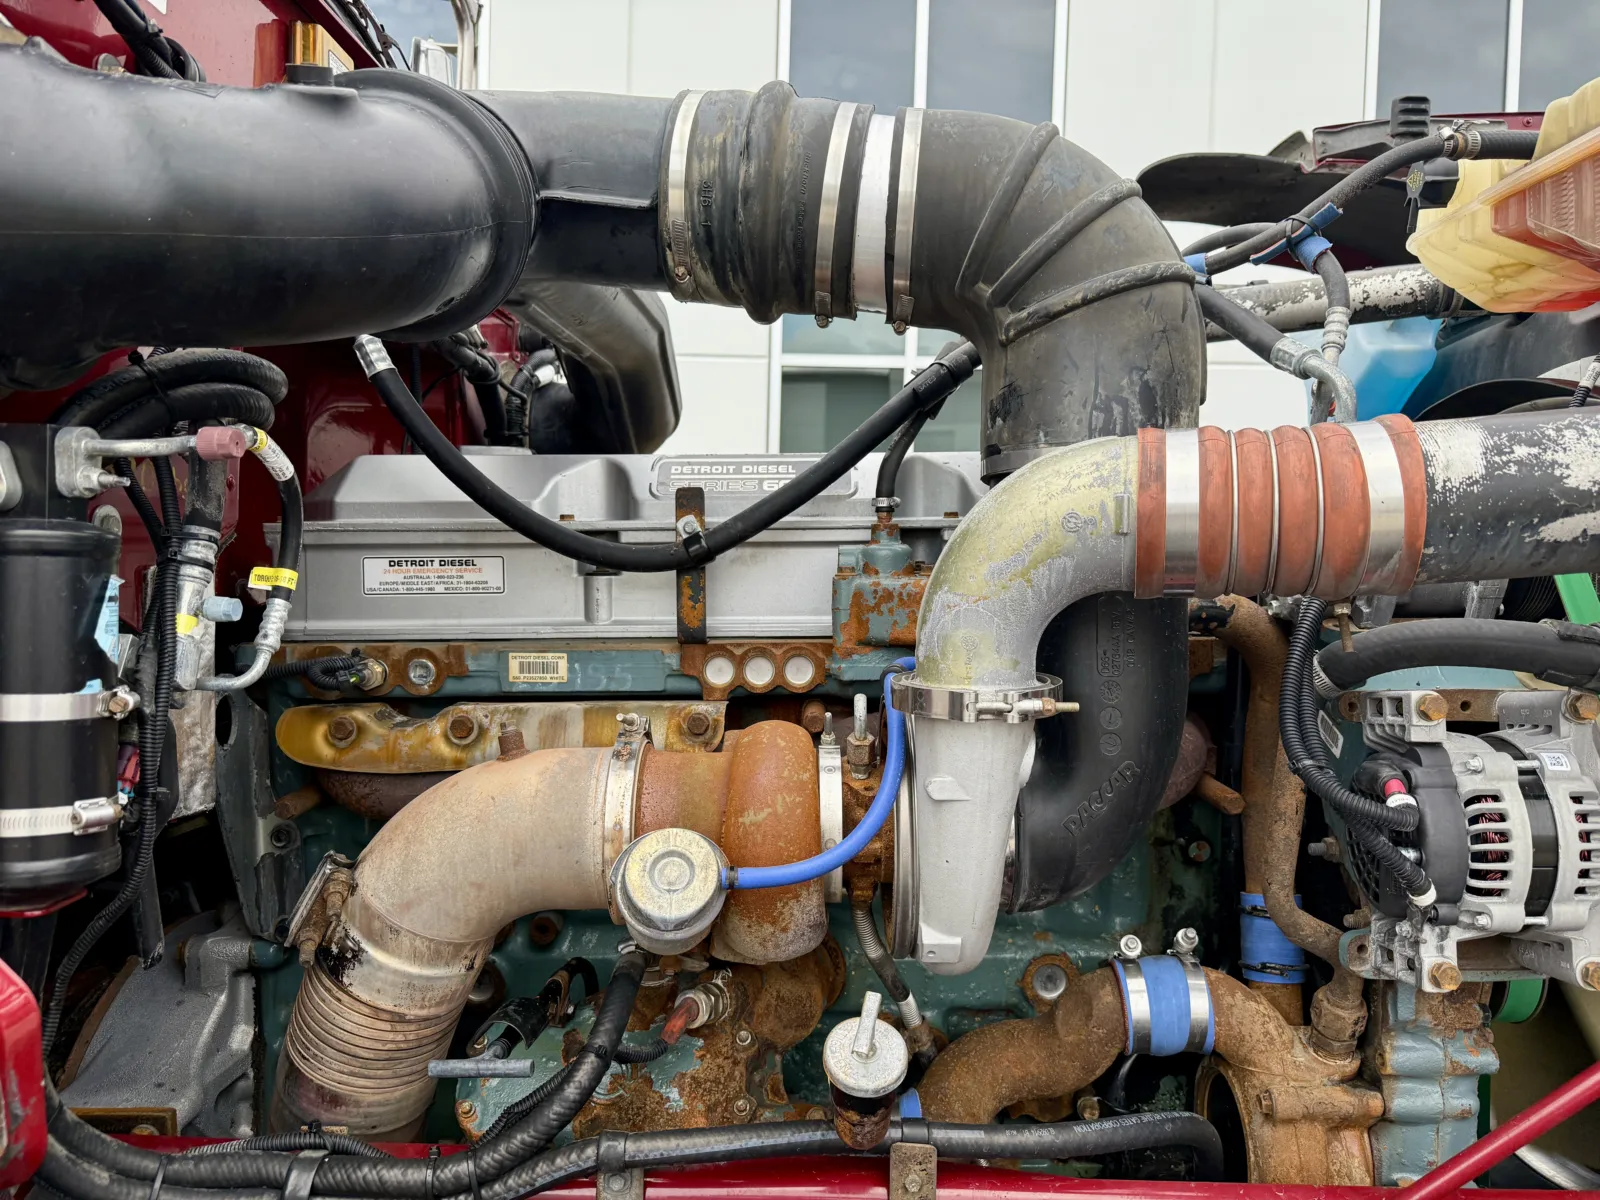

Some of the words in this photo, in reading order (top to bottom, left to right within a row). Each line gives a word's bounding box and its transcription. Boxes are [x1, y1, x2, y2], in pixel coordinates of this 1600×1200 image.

[671, 465, 736, 474] DETROIT
[742, 464, 796, 473] DIESEL
[439, 559, 477, 567] DIESEL
[1061, 760, 1141, 836] PACCAR
[1073, 1120, 1119, 1133] CORPORATION
[1119, 1118, 1140, 1127] GATES
